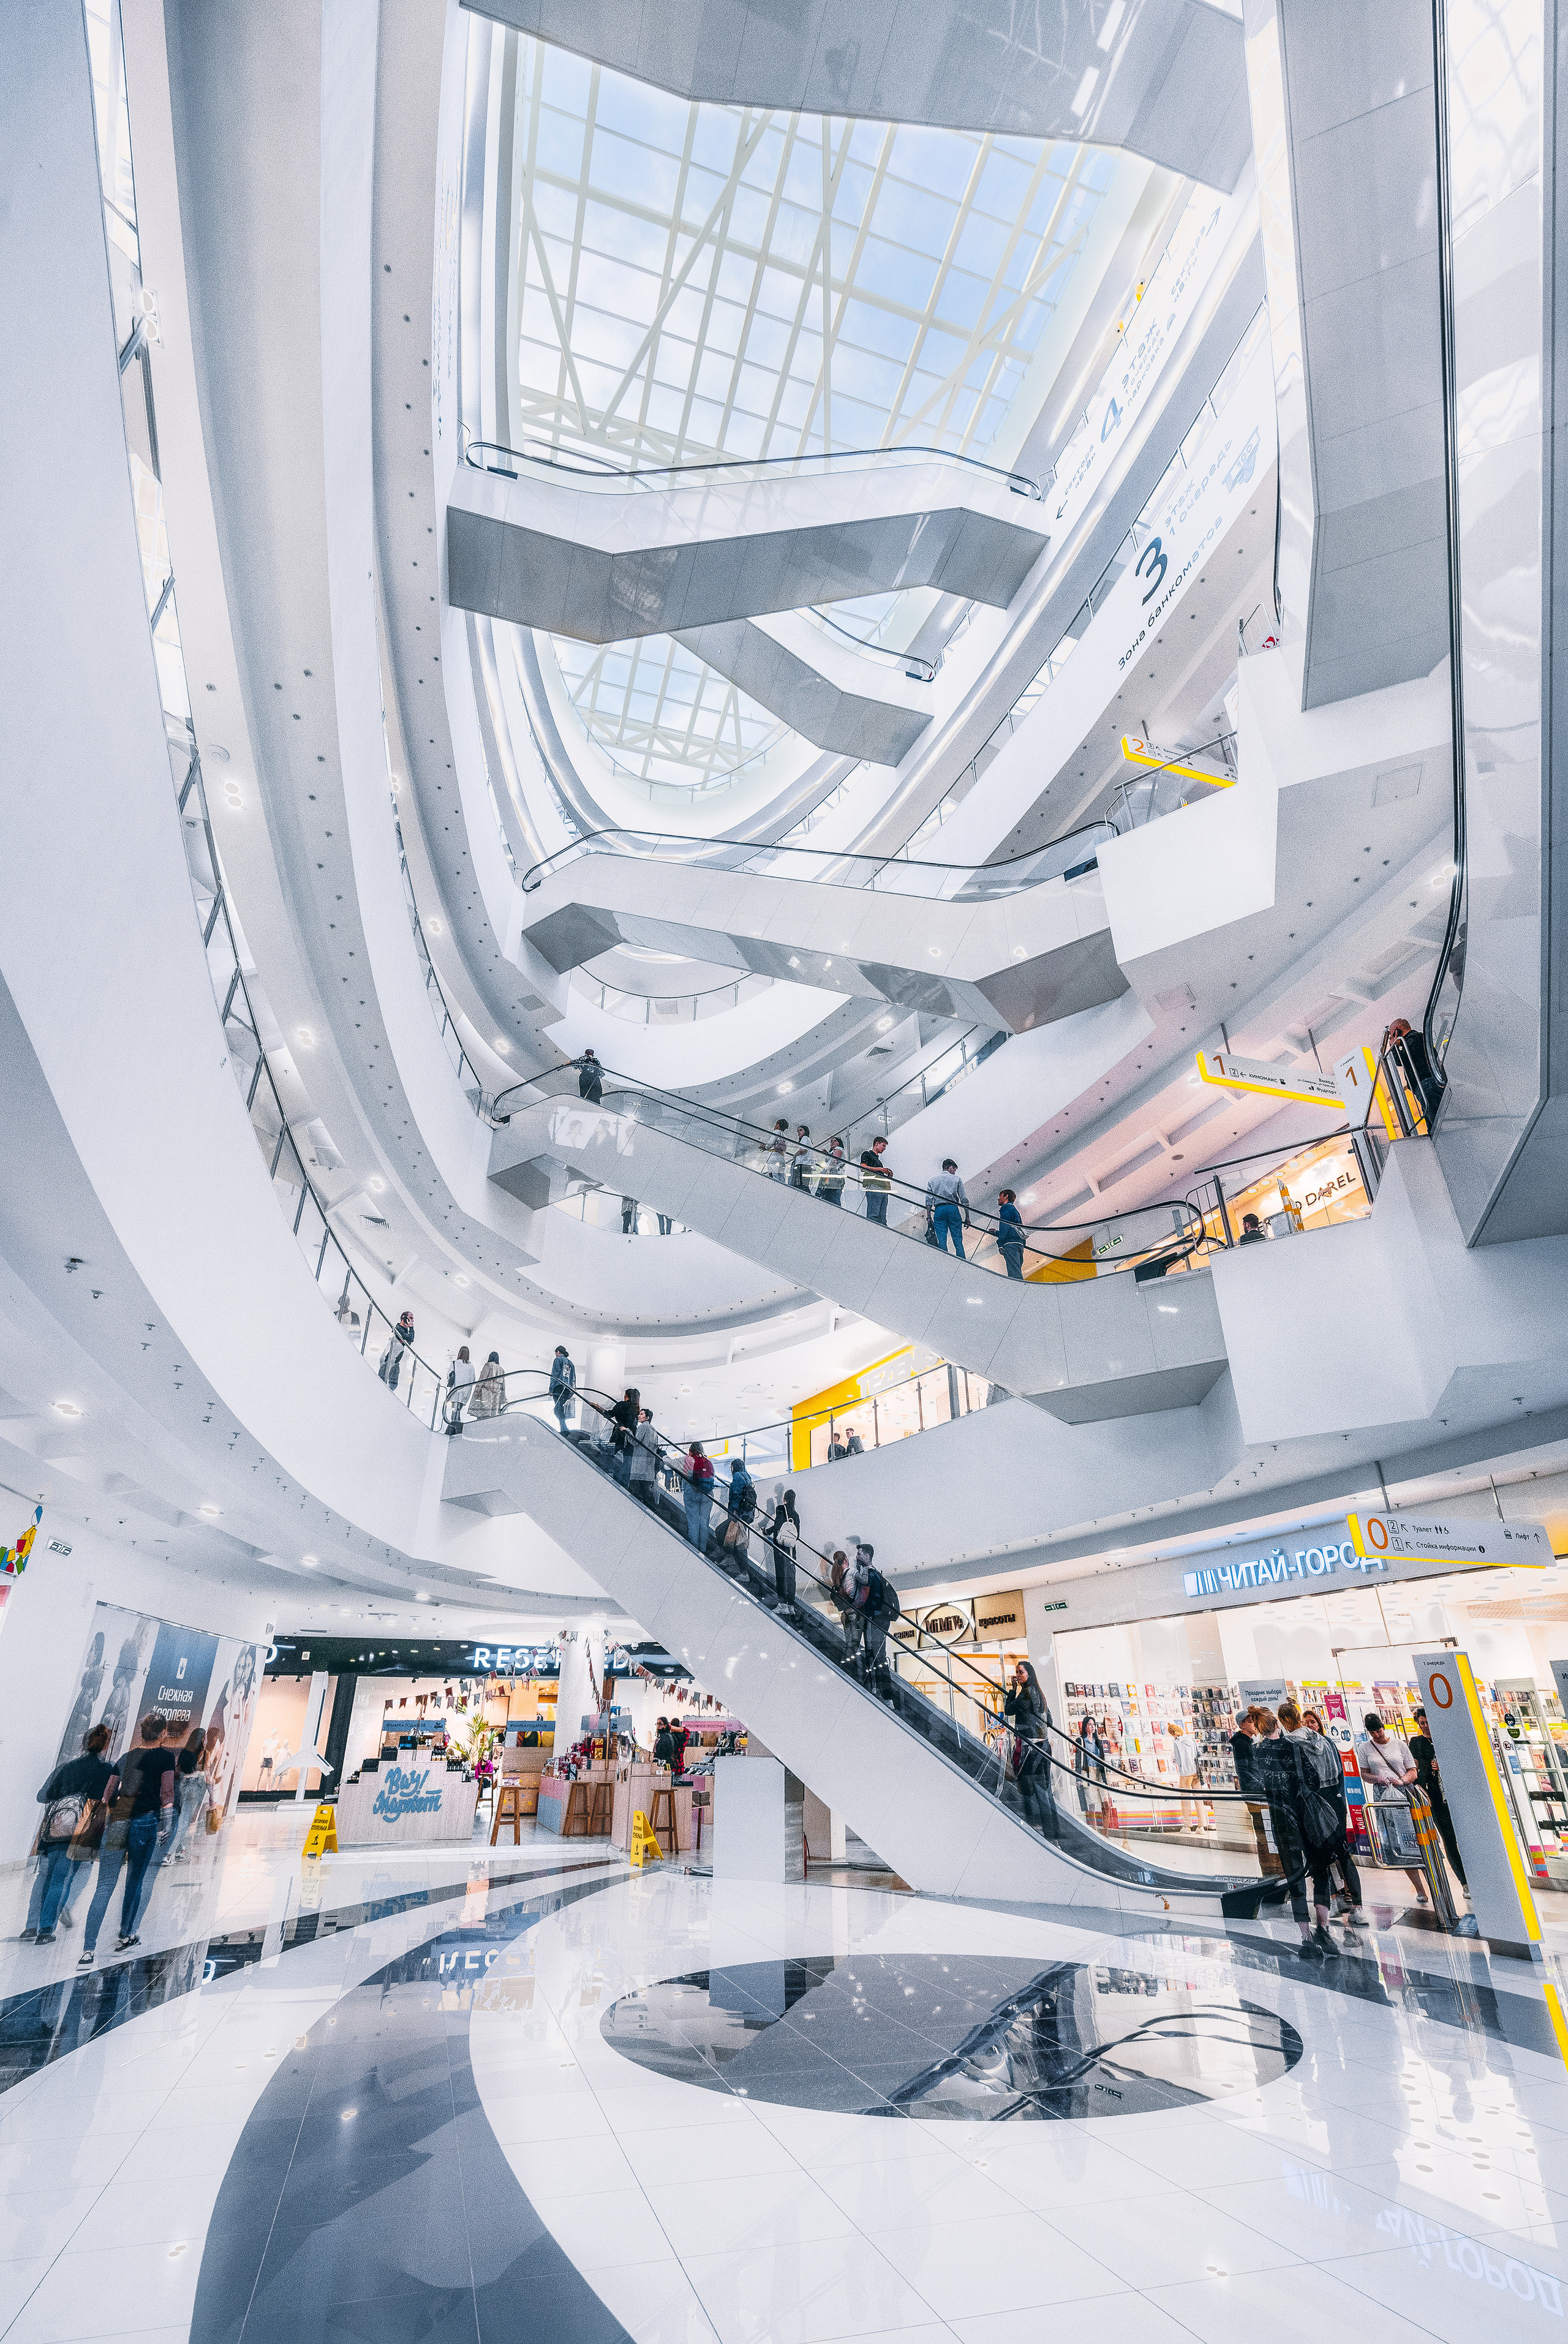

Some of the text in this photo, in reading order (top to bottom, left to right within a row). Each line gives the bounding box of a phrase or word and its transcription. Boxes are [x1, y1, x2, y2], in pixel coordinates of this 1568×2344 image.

[1171, 225, 1206, 295] сектора
[1121, 318, 1157, 389] этаж
[1127, 336, 1164, 407] парковка
[1129, 330, 1161, 384] очередь
[1101, 397, 1123, 443] 4
[1065, 445, 1095, 495] сектора
[1180, 440, 1232, 523] очередь
[1165, 479, 1194, 529] этаж
[1118, 516, 1223, 671] Зона банкоматов
[1135, 537, 1168, 606] 3
[1132, 739, 1146, 754] 2
[1213, 1055, 1225, 1076] 1
[1249, 1074, 1278, 1083] КИНОМАКС
[1346, 1066, 1357, 1087] 1
[1305, 1172, 1355, 1207] DAREL
[856, 1347, 940, 1399] TEZENIS
[1415, 1541, 1438, 1550] Стойка
[1439, 1543, 1477, 1553] информации
[1515, 1532, 1530, 1541] Лифт
[978, 1613, 1016, 1629] красоты
[157, 1685, 194, 1703] Снежная
